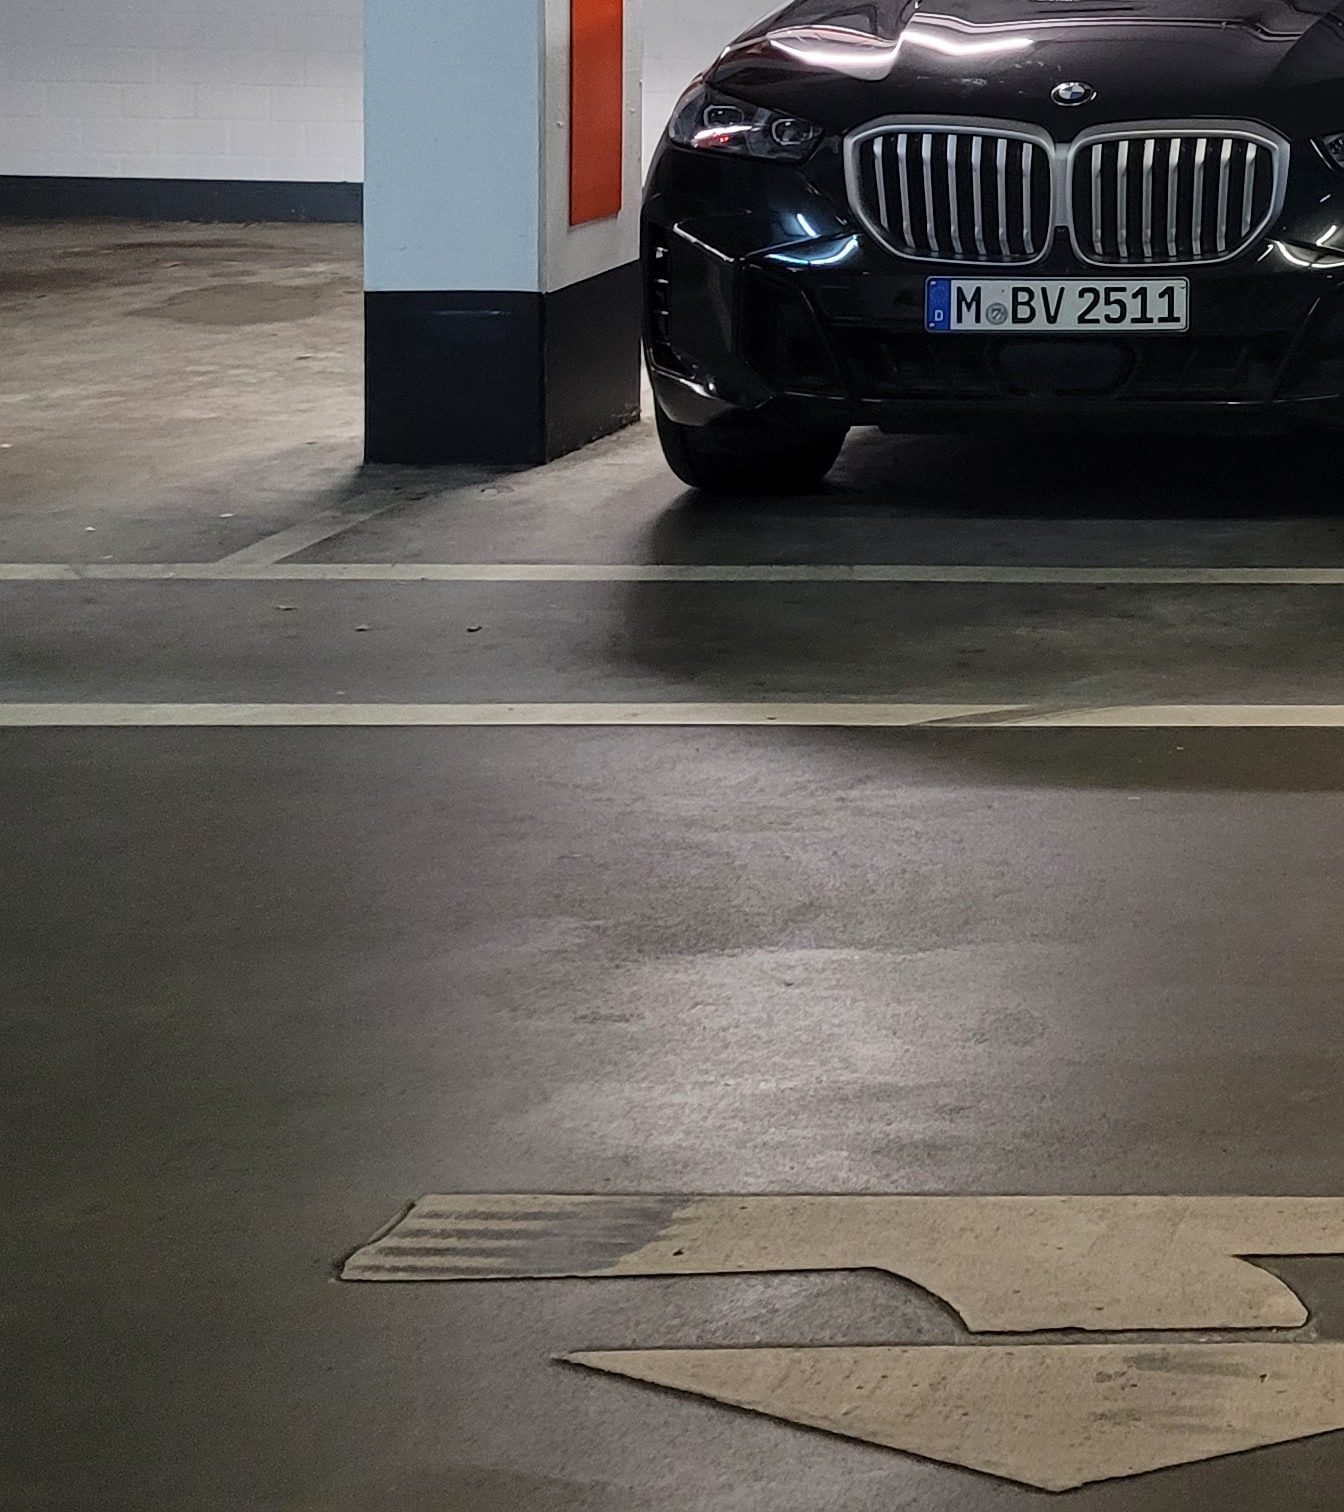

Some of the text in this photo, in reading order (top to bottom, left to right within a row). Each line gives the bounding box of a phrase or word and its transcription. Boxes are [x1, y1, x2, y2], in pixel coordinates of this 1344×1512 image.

[934, 285, 1181, 325] D M BV 2511
